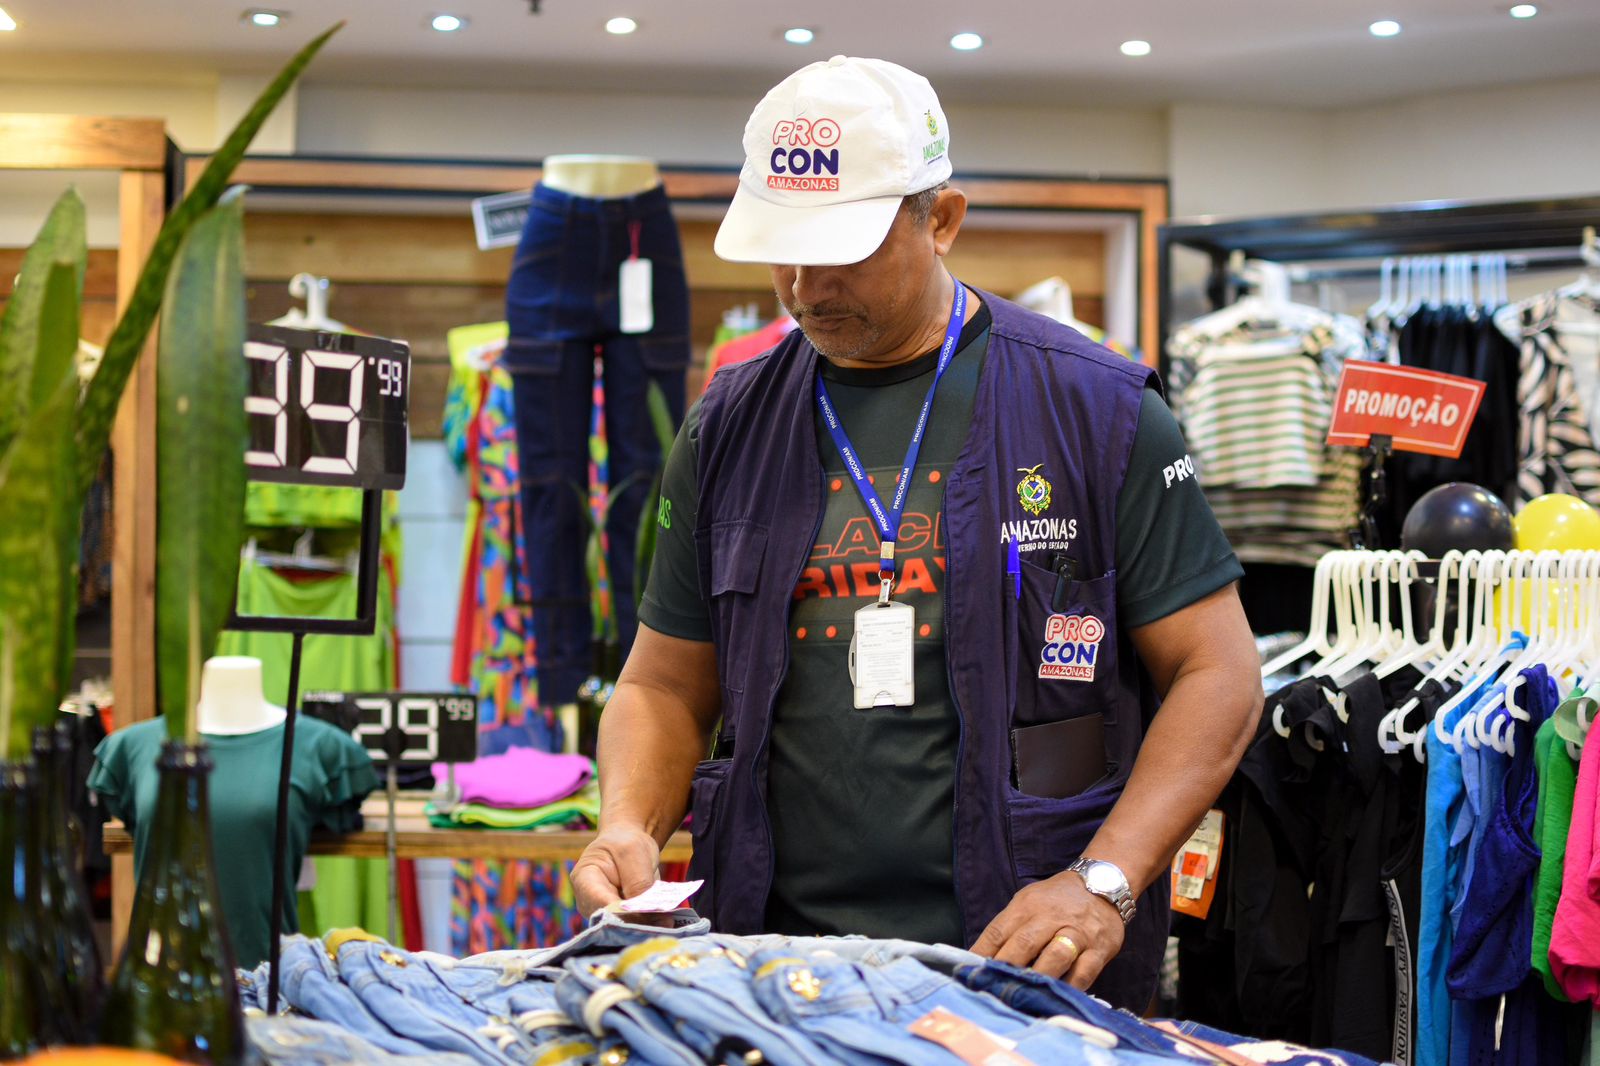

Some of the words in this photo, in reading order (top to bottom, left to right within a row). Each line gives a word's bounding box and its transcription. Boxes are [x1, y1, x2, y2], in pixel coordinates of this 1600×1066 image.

[773, 118, 841, 148] PRO
[770, 147, 839, 176] CON
[767, 177, 838, 191] AMAZONAS
[1344, 388, 1460, 427] PROMOÇÃO
[1162, 454, 1197, 489] PRO
[1000, 518, 1078, 544] AMAZONAS
[1037, 541, 1047, 550] DO
[794, 557, 945, 599] RIDA
[1046, 616, 1103, 643] PRO
[1042, 642, 1096, 666] CON
[1041, 665, 1092, 678] AMAZONAS
[351, 699, 438, 760] 29
[1396, 990, 1408, 1061] FASHION
